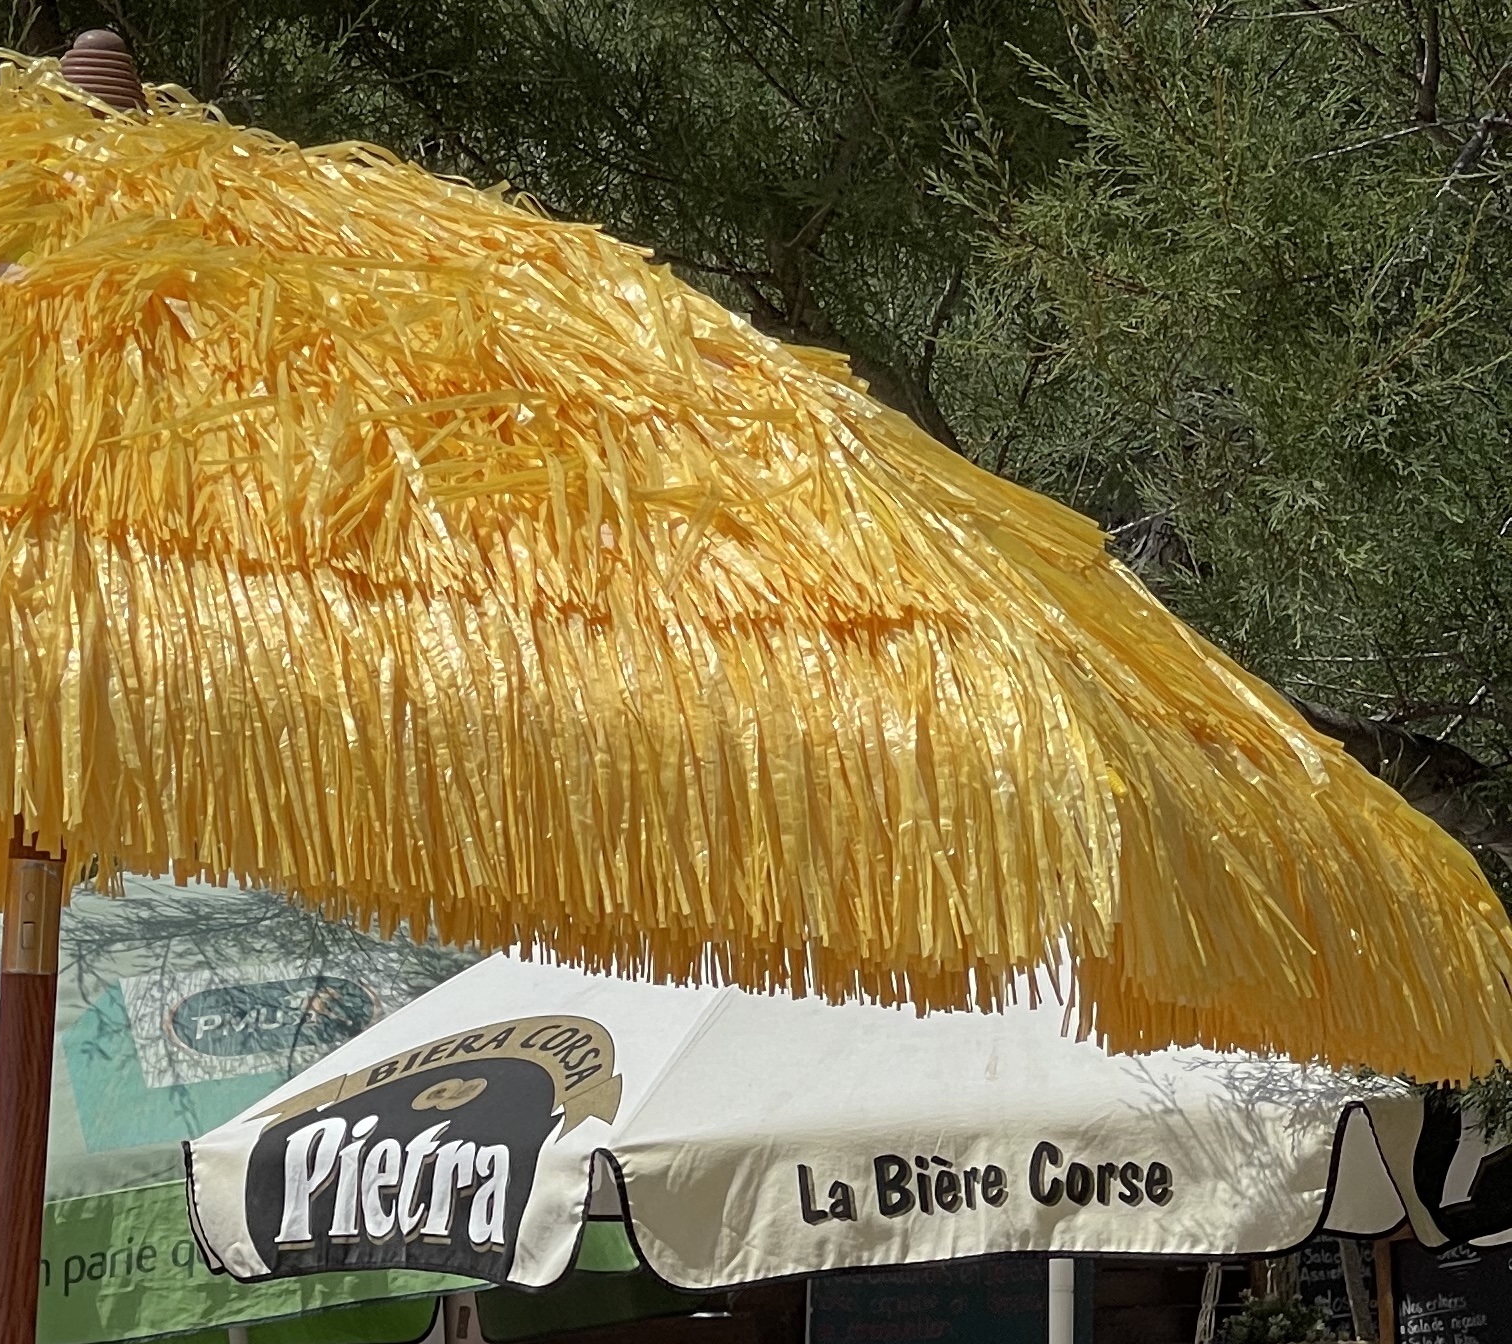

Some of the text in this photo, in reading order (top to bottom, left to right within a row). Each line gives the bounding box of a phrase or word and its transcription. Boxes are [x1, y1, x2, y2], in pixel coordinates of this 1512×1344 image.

[190, 1007, 284, 1041] PMU
[366, 1024, 603, 1092] BIERA CORSA
[274, 1114, 511, 1253] Pietra
[797, 1139, 1173, 1226] La Bière Corse
[64, 1236, 158, 1298] parie
